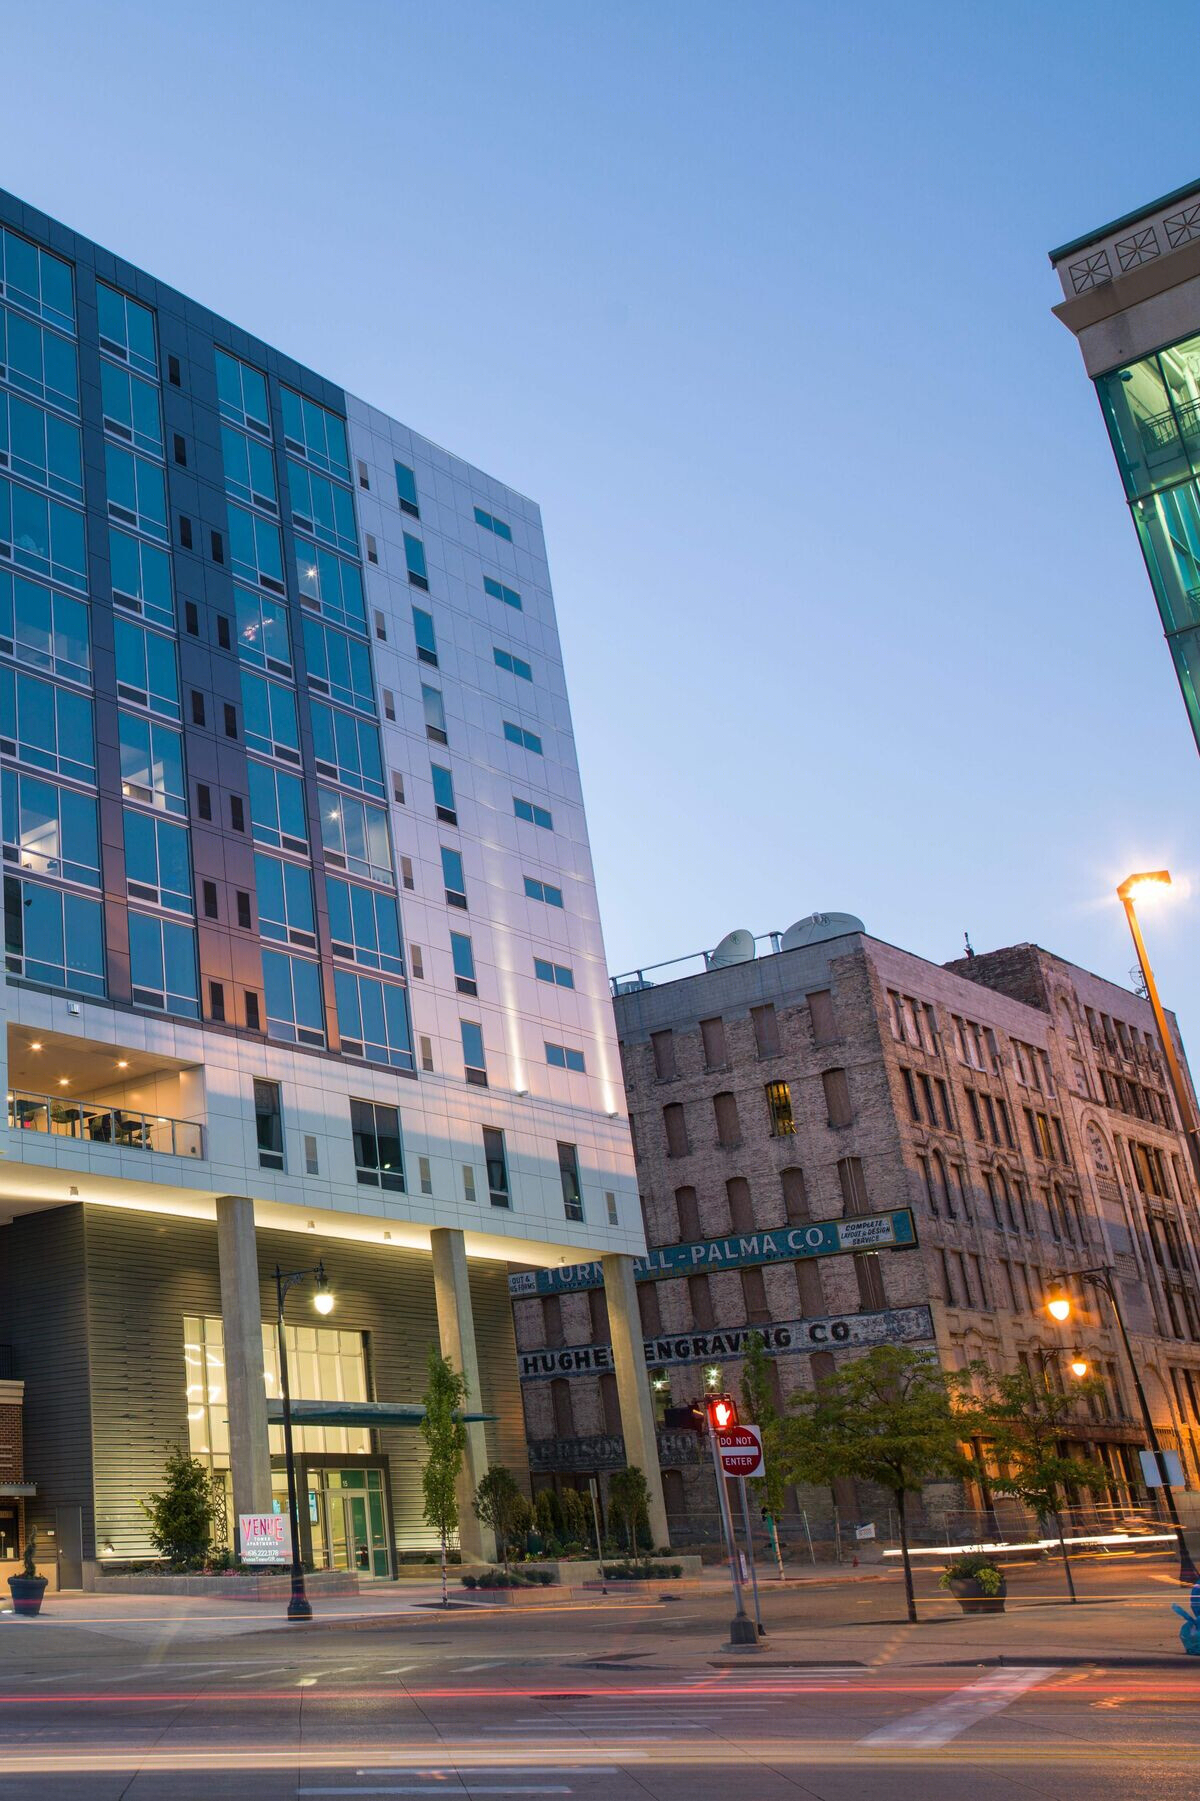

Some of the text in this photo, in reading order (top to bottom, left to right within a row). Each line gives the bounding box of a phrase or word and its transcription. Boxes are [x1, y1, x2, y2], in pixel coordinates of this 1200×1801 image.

[787, 1227, 831, 1250] CO.
[852, 1235, 880, 1246] SERVICE
[523, 1348, 615, 1374] HUGHE
[720, 1436, 752, 1446] DO NOT
[725, 1457, 753, 1466] ENTER
[241, 1516, 285, 1542] VENUE
